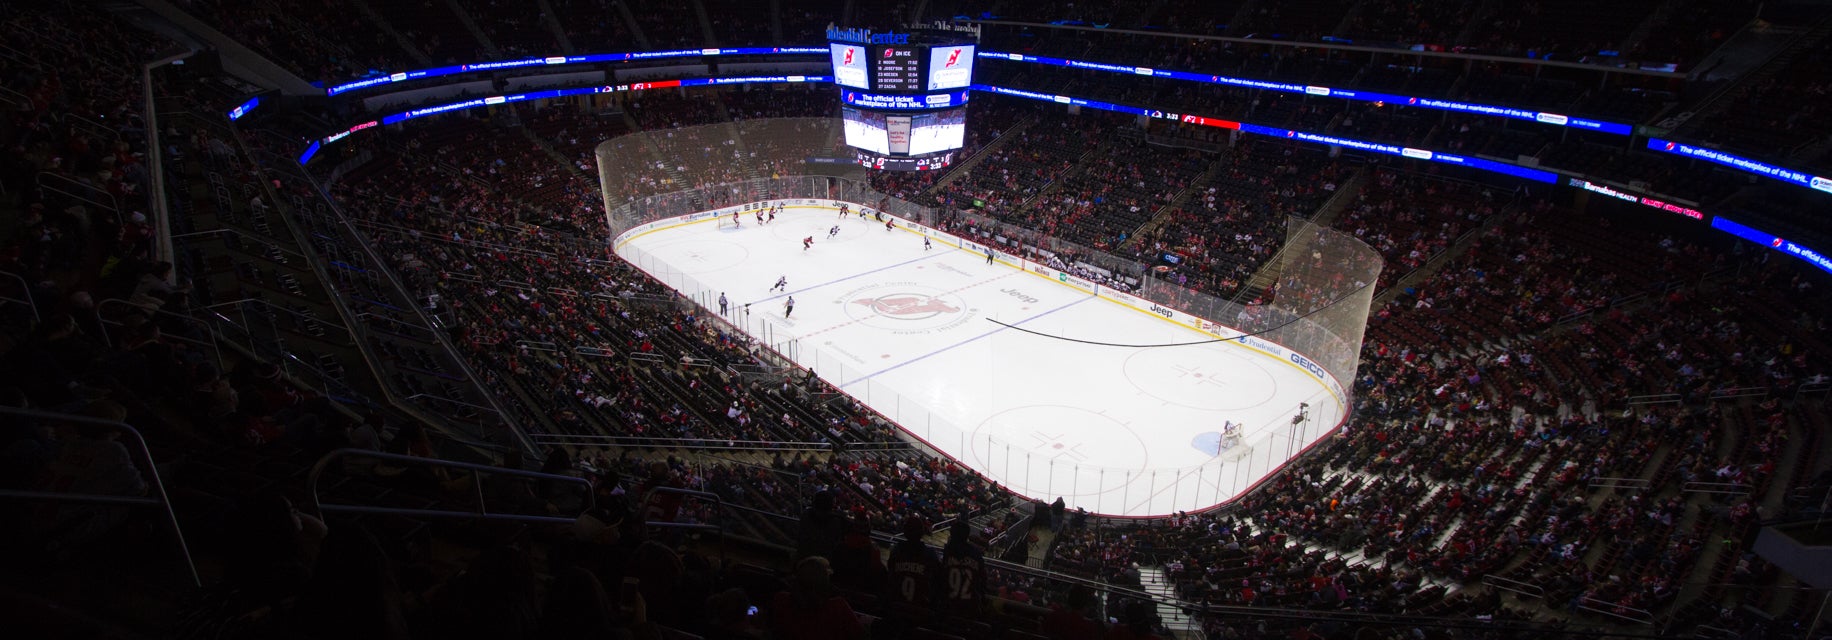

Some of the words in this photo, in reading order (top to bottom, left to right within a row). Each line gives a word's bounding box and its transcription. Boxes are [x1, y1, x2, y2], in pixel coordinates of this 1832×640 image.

[864, 29, 910, 44] Center
[1694, 149, 1716, 158] official
[1717, 153, 1733, 163] ticket
[1734, 159, 1770, 173] marketplace
[1780, 169, 1790, 178] the
[1788, 244, 1800, 253] The
[1000, 288, 1039, 304] Jeep
[1150, 304, 1173, 318] Jeep
[1249, 339, 1282, 356] Prudential
[1290, 353, 1324, 379] GEICO
[902, 576, 915, 601] 9
[948, 568, 973, 599] 92
